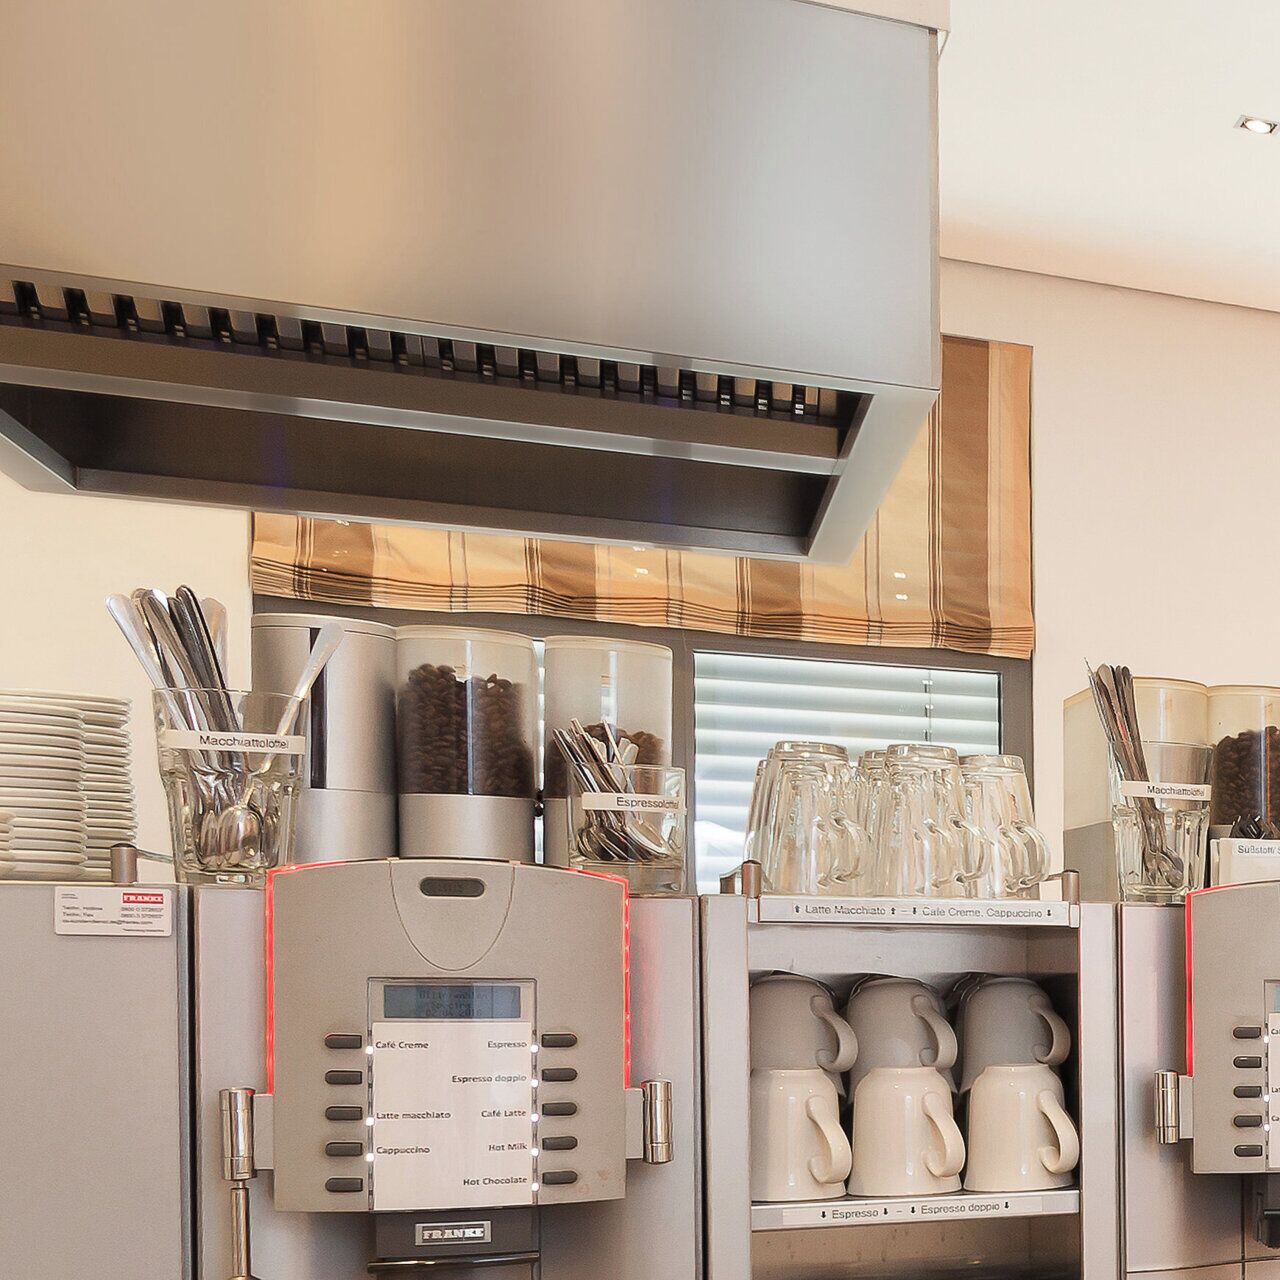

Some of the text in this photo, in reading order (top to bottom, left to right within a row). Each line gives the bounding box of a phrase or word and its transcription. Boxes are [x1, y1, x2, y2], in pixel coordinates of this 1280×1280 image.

[805, 905, 832, 914] Latte
[834, 905, 887, 915] Macchiato
[986, 907, 1042, 919] Cappuccino
[375, 1041, 429, 1049] Café Creme
[487, 1041, 528, 1049] Espresso
[452, 1074, 527, 1083] Espresso doppio
[376, 1111, 451, 1120] Latte macchiato
[481, 1109, 527, 1118] Café Latte
[376, 1146, 431, 1155] Cappuccino
[507, 1142, 528, 1151] Milk
[463, 1176, 528, 1186] Hot Chocolate
[832, 1202, 1000, 1219] Espresso Espresso doppio
[422, 1228, 485, 1240] FRANKE
